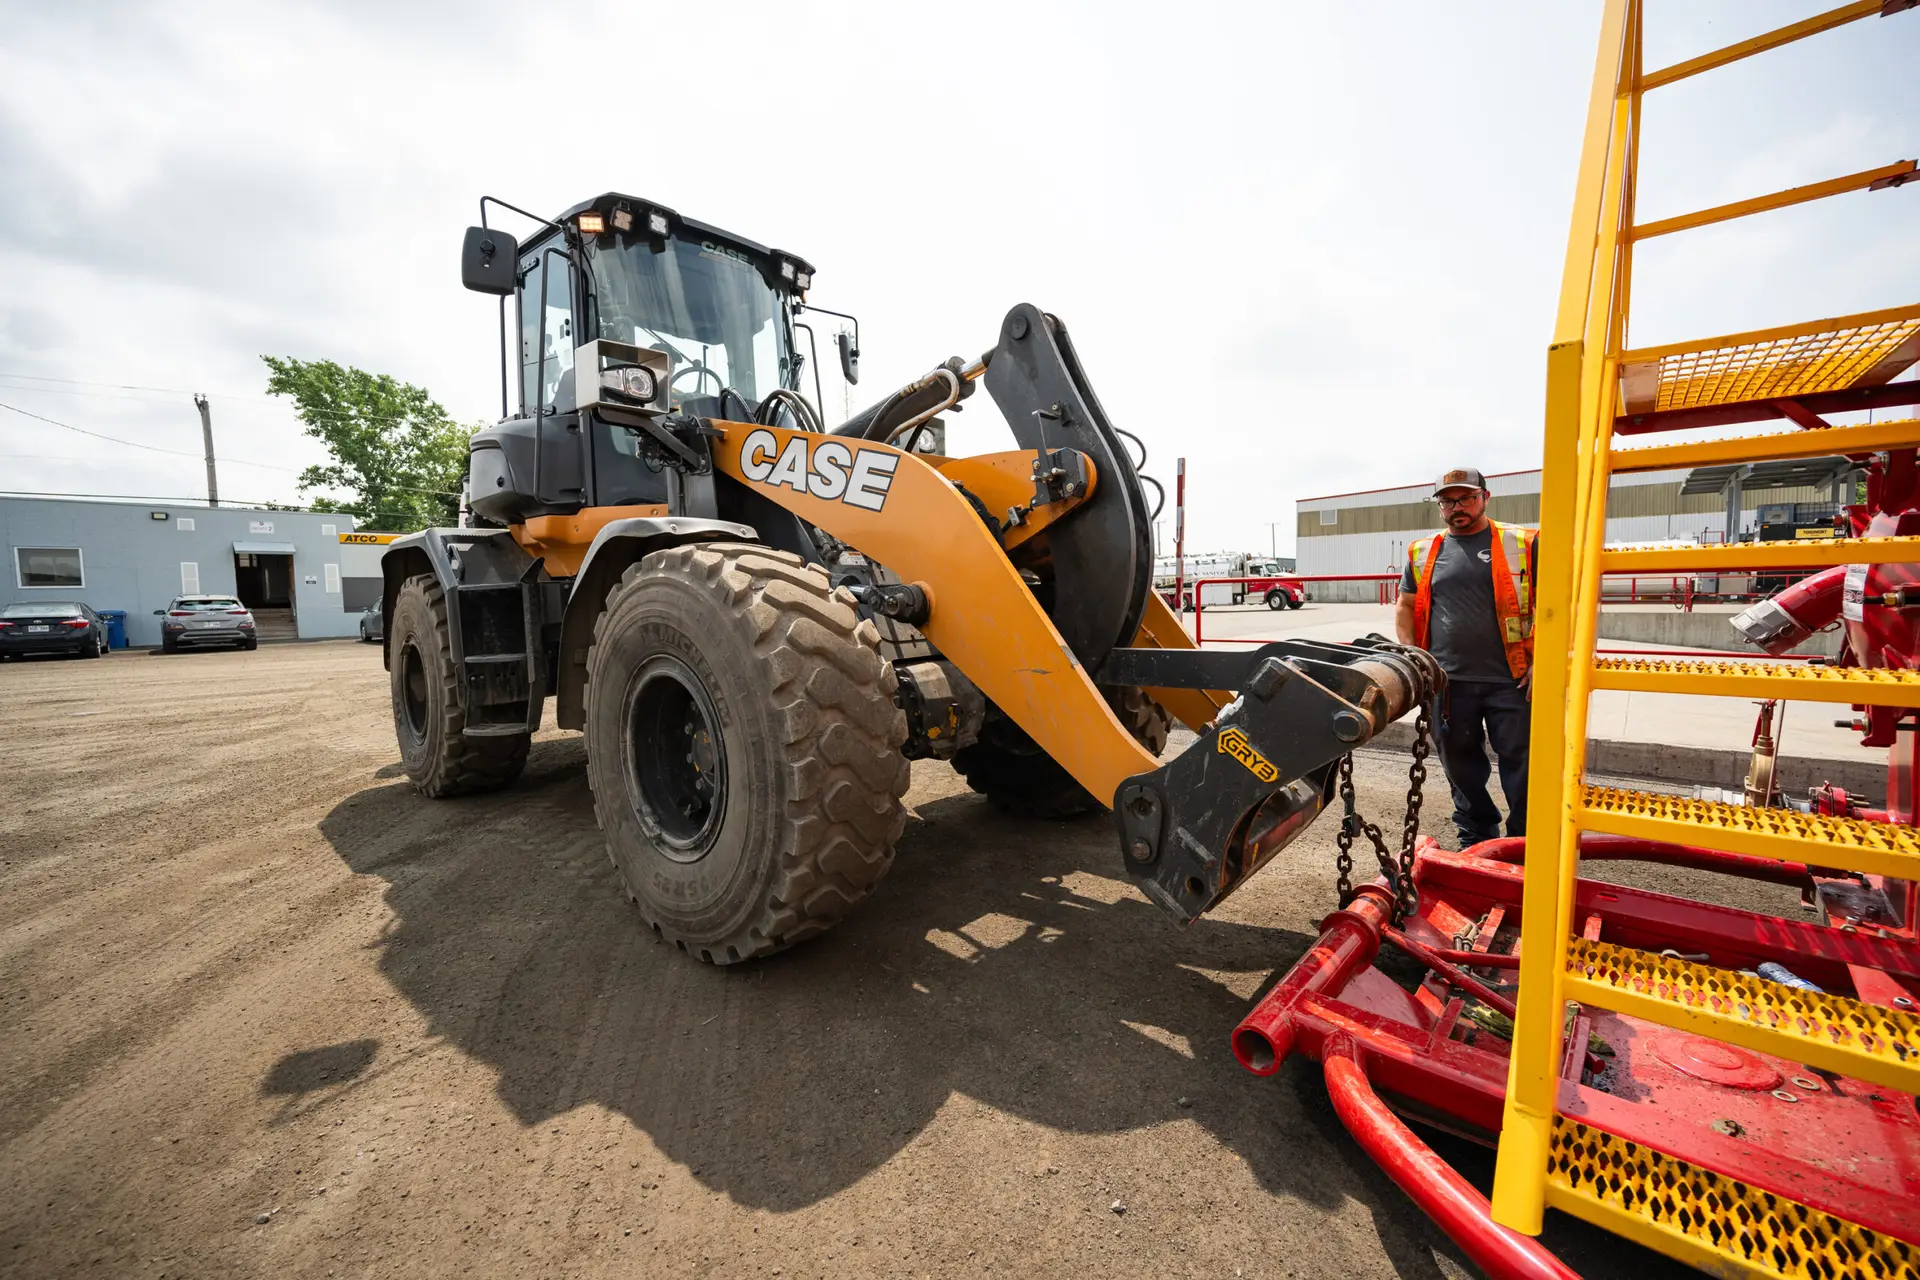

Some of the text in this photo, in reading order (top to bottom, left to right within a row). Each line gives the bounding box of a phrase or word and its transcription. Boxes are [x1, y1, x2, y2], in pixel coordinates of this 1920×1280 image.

[701, 240, 749, 265] CASE
[740, 428, 900, 513] CASE
[344, 534, 378, 543] ATCO
